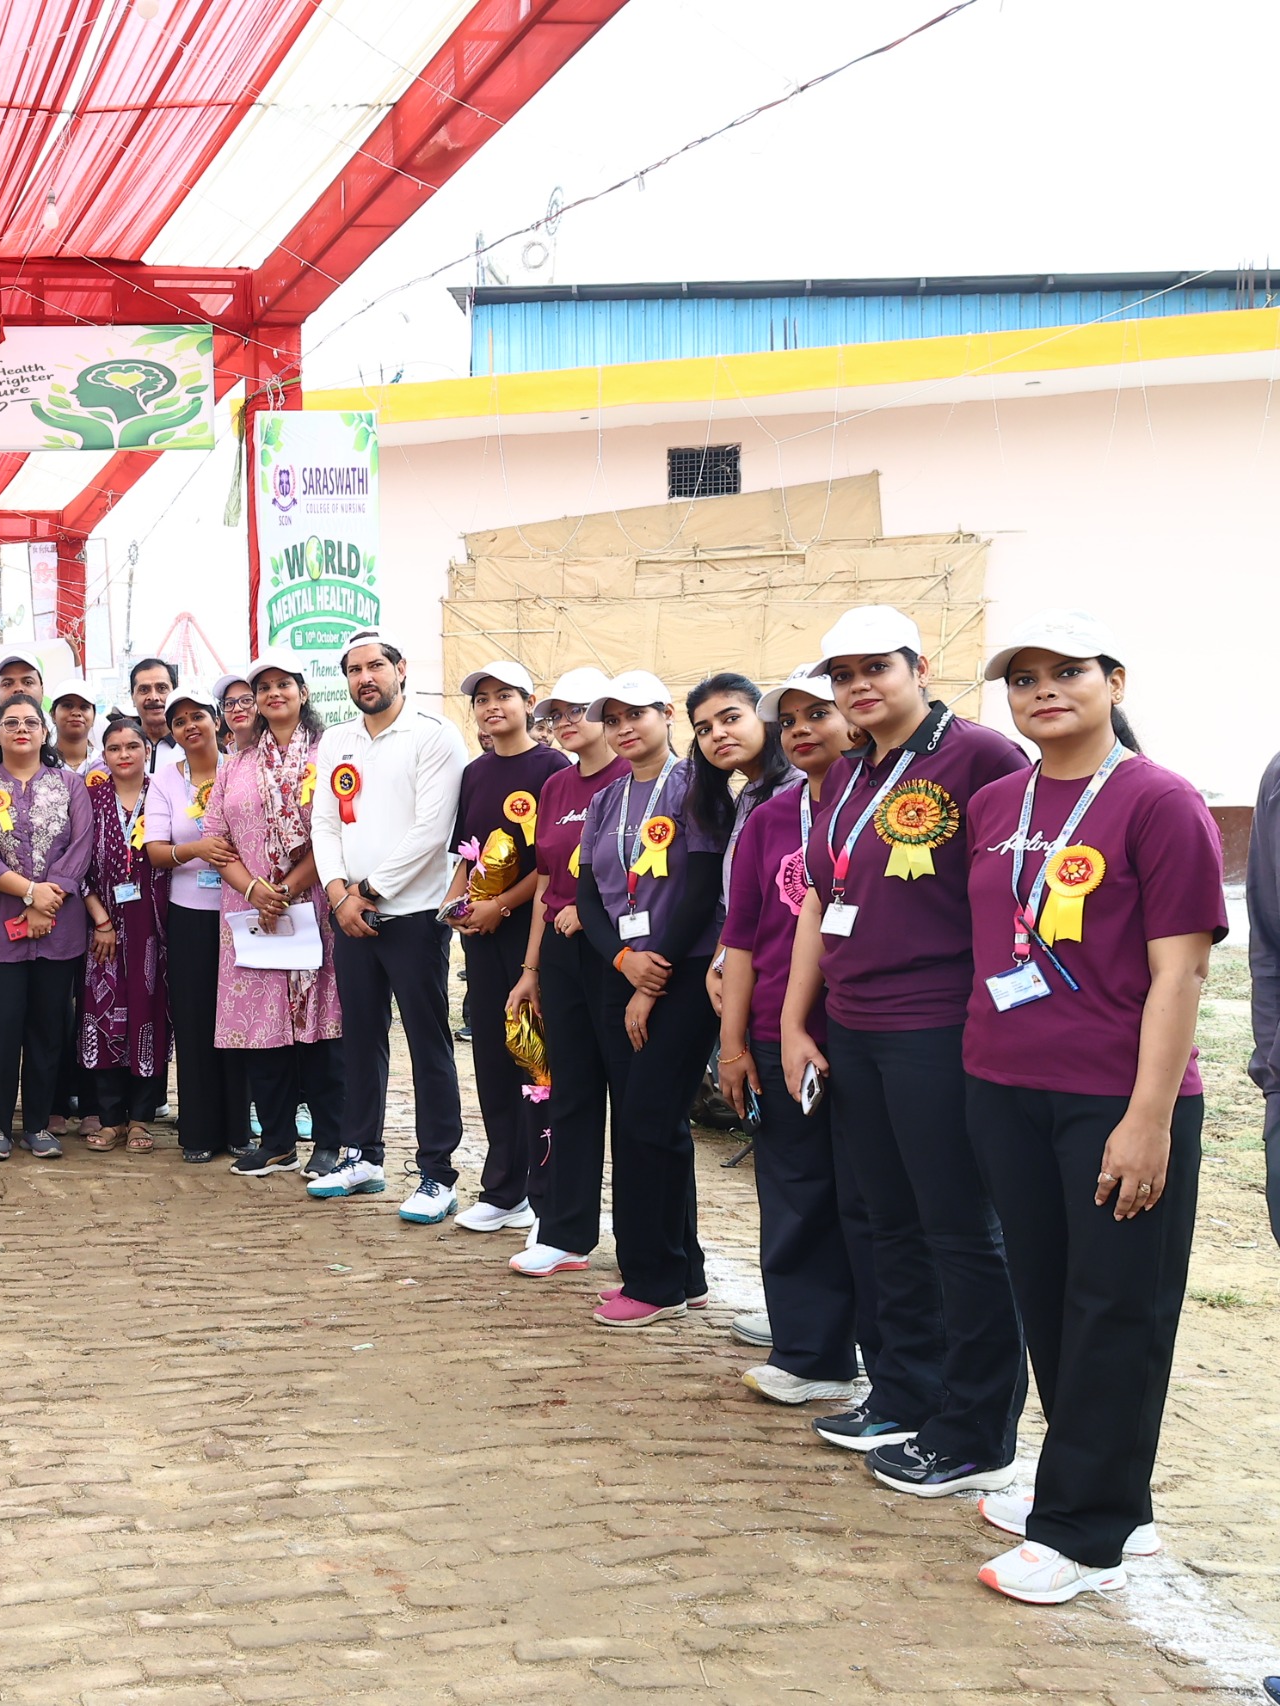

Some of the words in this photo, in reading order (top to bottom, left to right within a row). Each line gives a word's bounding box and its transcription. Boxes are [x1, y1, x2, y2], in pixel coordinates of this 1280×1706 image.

[302, 467, 368, 495] SARASWATHI
[306, 503, 330, 514] COLLEGE
[332, 503, 338, 514] OF
[341, 503, 366, 514] NURSING
[279, 515, 292, 526] SCON
[271, 587, 315, 627] MENTAL
[315, 585, 355, 613] HEALTH
[356, 592, 378, 625] DAY
[305, 631, 316, 644] 10th
[317, 631, 340, 644] October
[310, 659, 340, 678] Theme:
[325, 705, 341, 723] real
